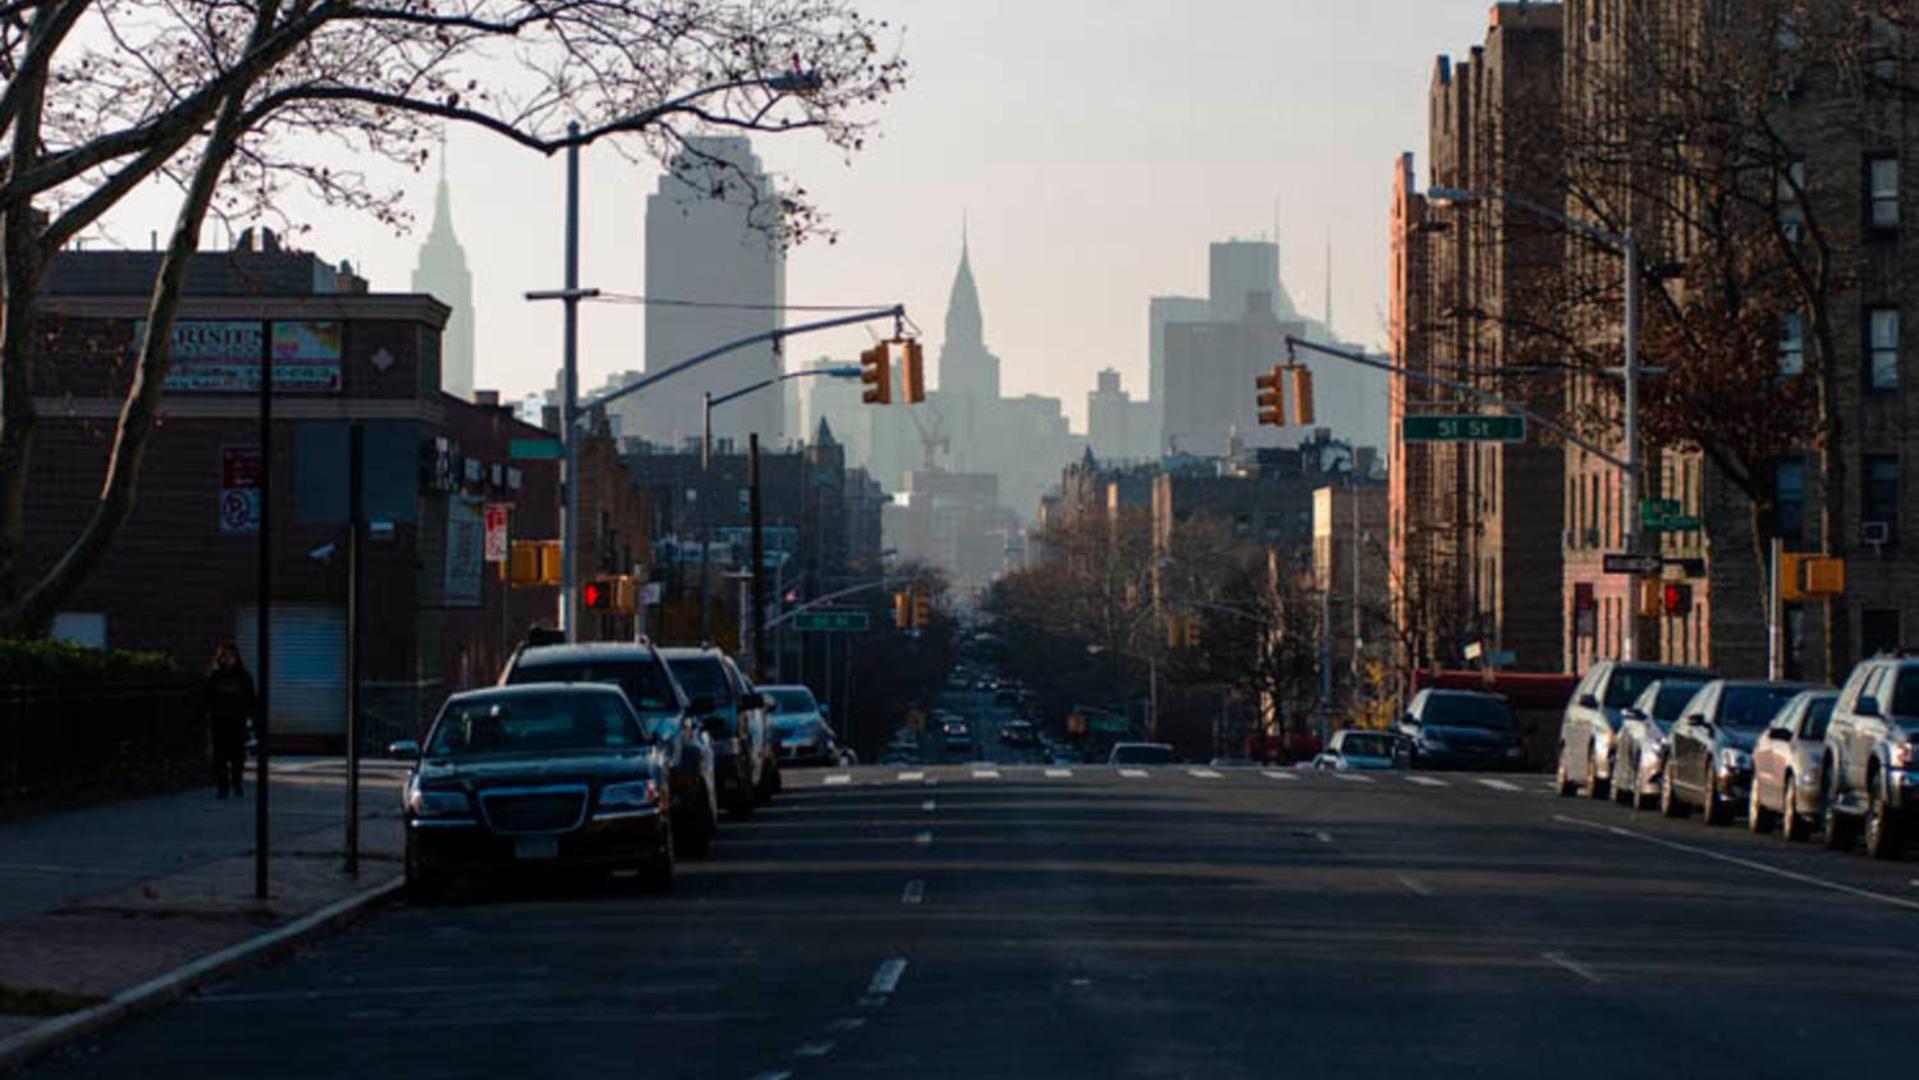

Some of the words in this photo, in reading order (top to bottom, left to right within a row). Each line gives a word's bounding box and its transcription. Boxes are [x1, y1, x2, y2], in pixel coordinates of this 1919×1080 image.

[170, 329, 263, 346] RISIEN
[1438, 421, 1457, 436] 51
[1468, 421, 1489, 436] St
